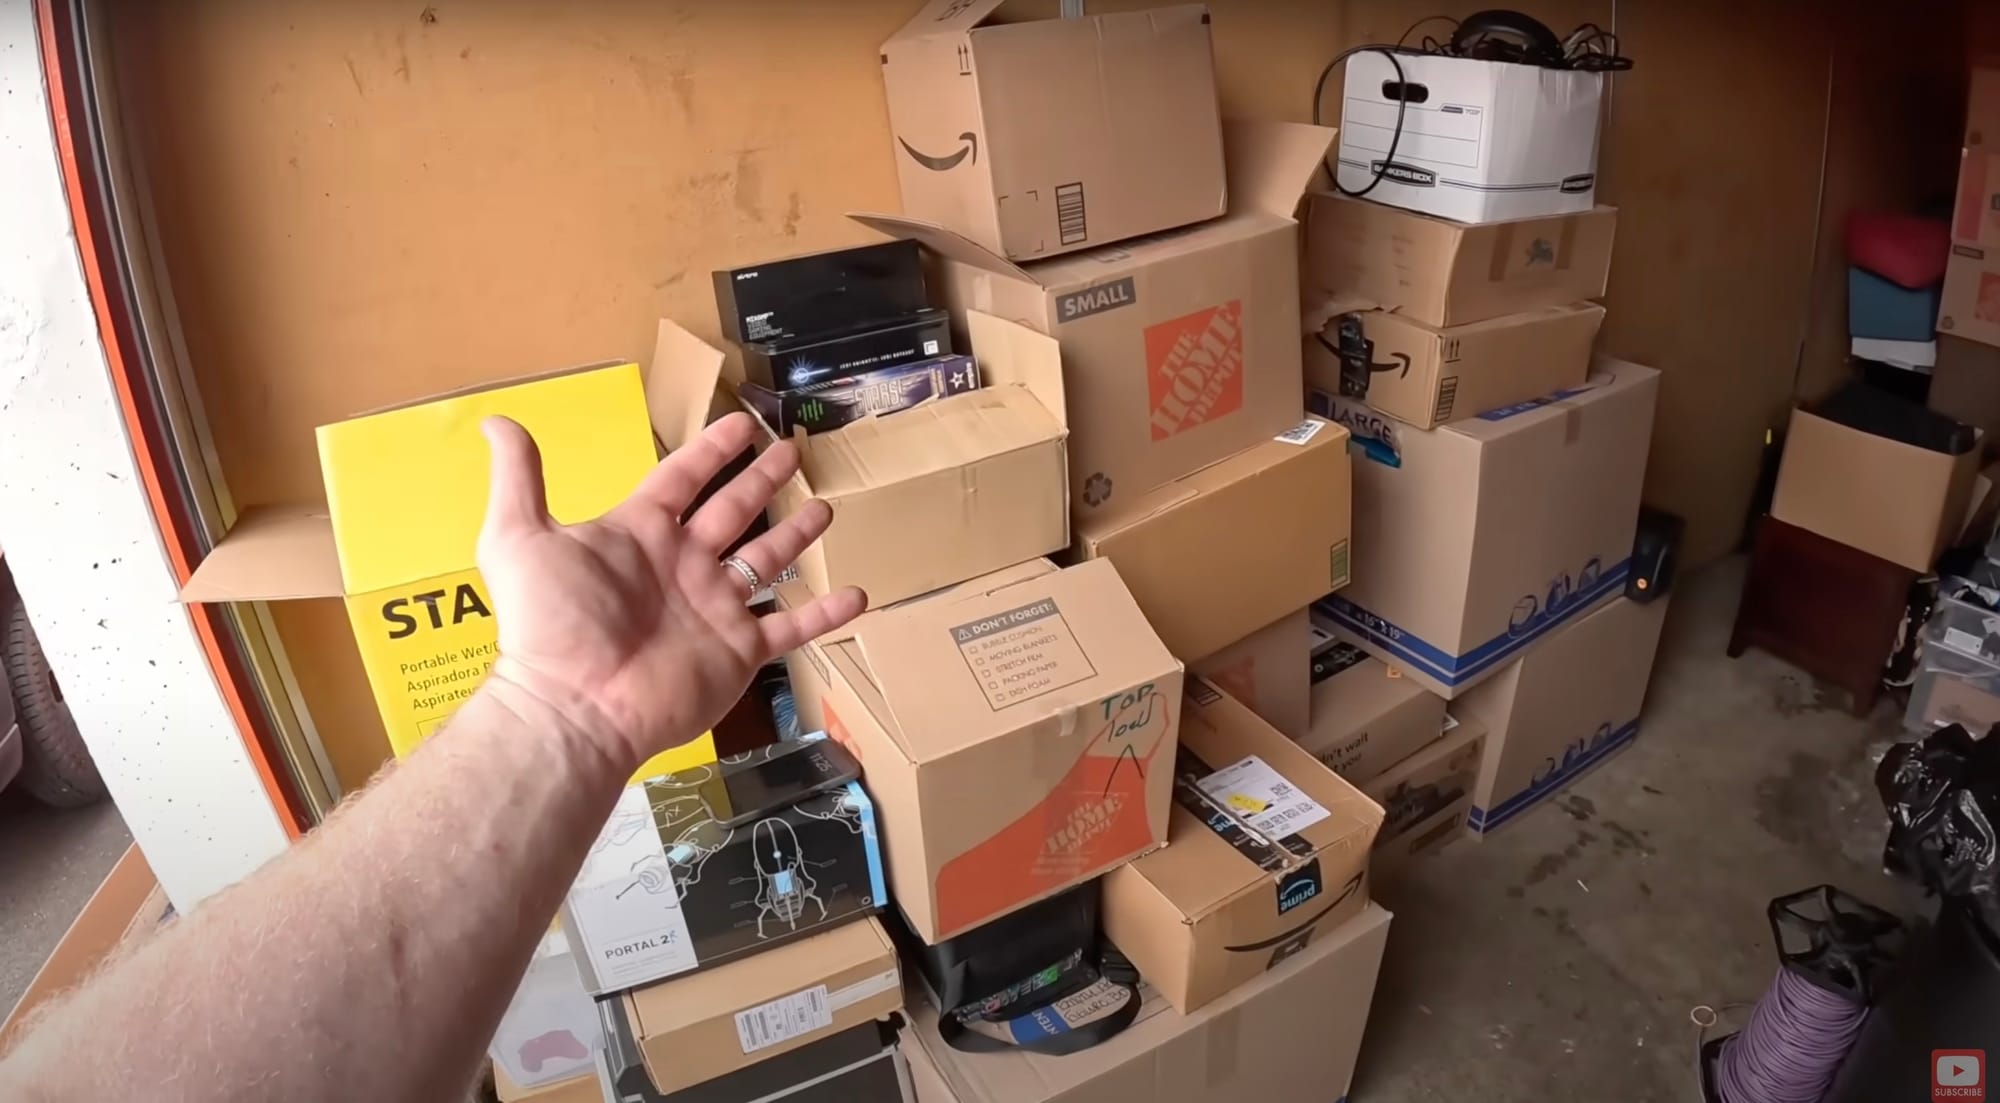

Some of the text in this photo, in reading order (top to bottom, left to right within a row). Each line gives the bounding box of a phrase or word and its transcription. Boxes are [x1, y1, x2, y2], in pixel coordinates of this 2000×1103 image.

[1412, 171, 1432, 183] BOX
[1064, 285, 1129, 317] SMALL
[1159, 329, 1198, 379] THE
[1151, 305, 1241, 435] HOME
[1187, 343, 1242, 424] DEPOT
[1331, 401, 1393, 445] LARGE
[972, 603, 1053, 635] DON'T FORGET:
[981, 625, 1043, 650] BUBBLE CUSHION
[989, 634, 1058, 661] MOVING BLANKETS
[400, 652, 458, 675] Portable
[995, 653, 1043, 673] STRETCH FILM
[1002, 661, 1058, 685] PACKING PAPER
[407, 666, 480, 693] Aspiradora
[1009, 678, 1051, 698] DISH FOAM
[1345, 732, 1368, 752] wait
[1046, 793, 1122, 854] HOME
[1280, 883, 1315, 911] prime
[605, 939, 659, 959] PORTAL
[660, 934, 670, 945] 2
